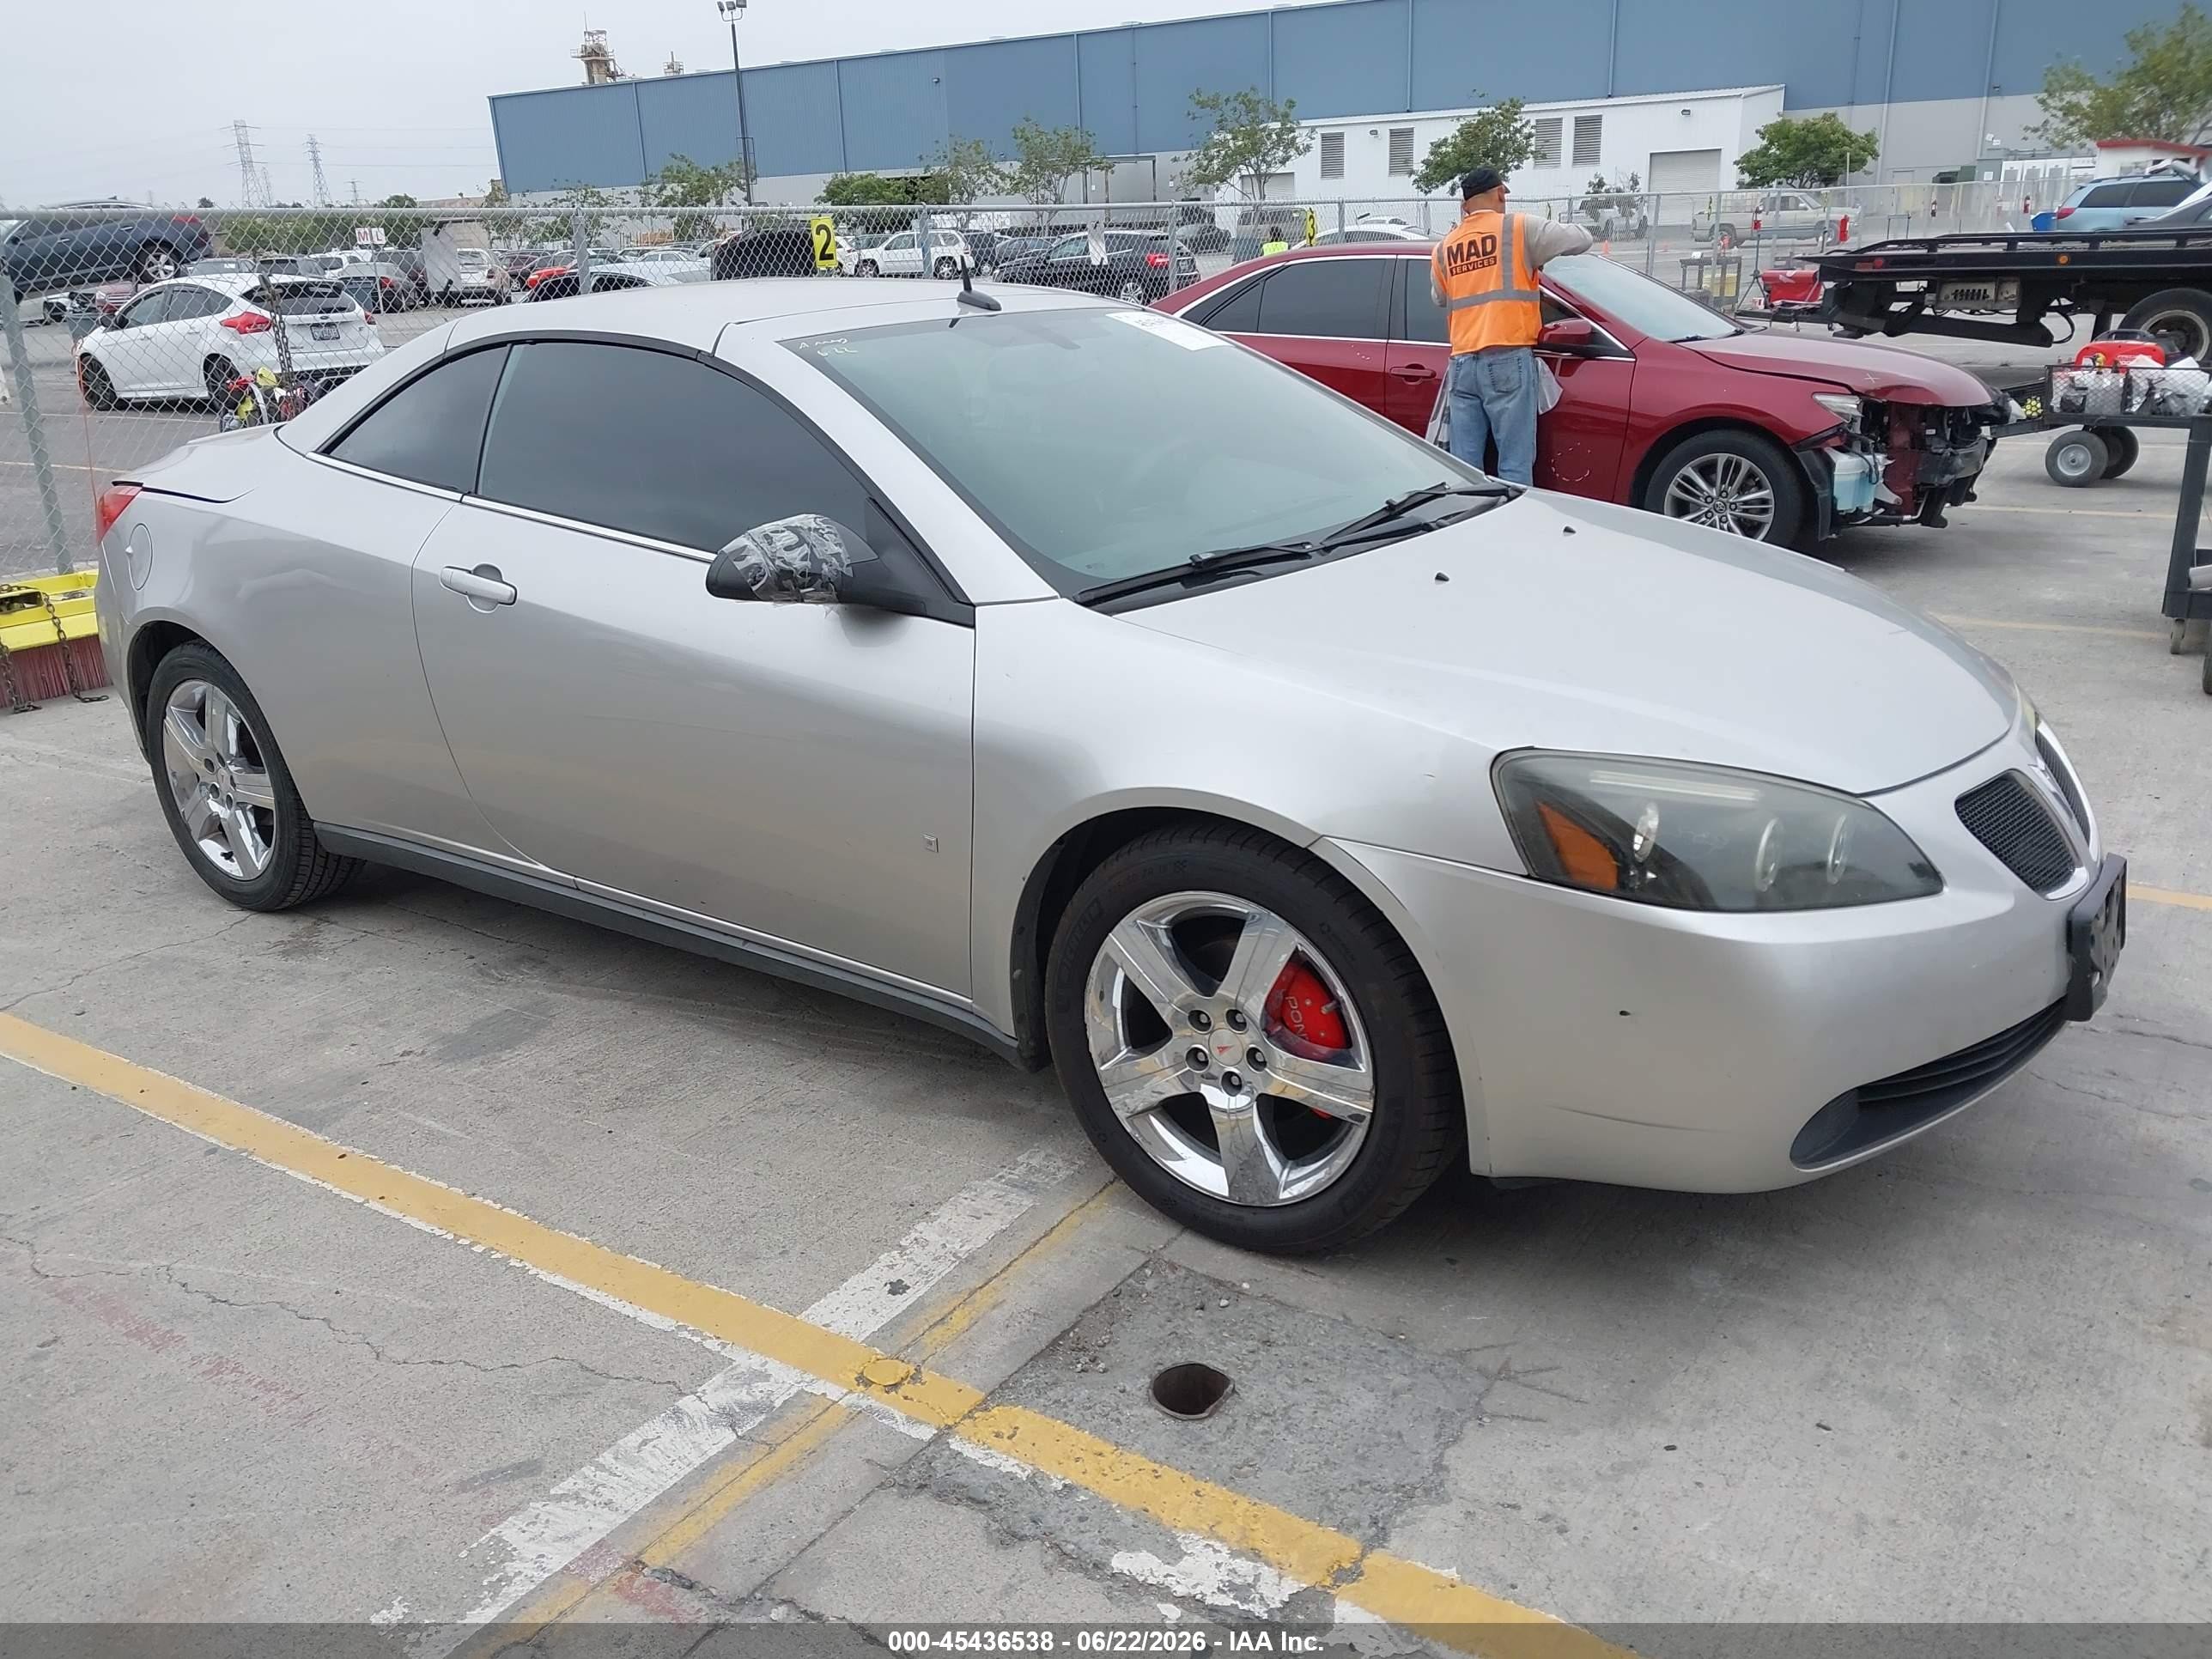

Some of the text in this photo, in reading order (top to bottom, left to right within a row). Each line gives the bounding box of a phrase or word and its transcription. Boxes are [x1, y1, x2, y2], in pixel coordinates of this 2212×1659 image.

[816, 223, 834, 261] 2
[1447, 234, 1497, 266] MAD
[1451, 258, 1495, 276] SERVICES
